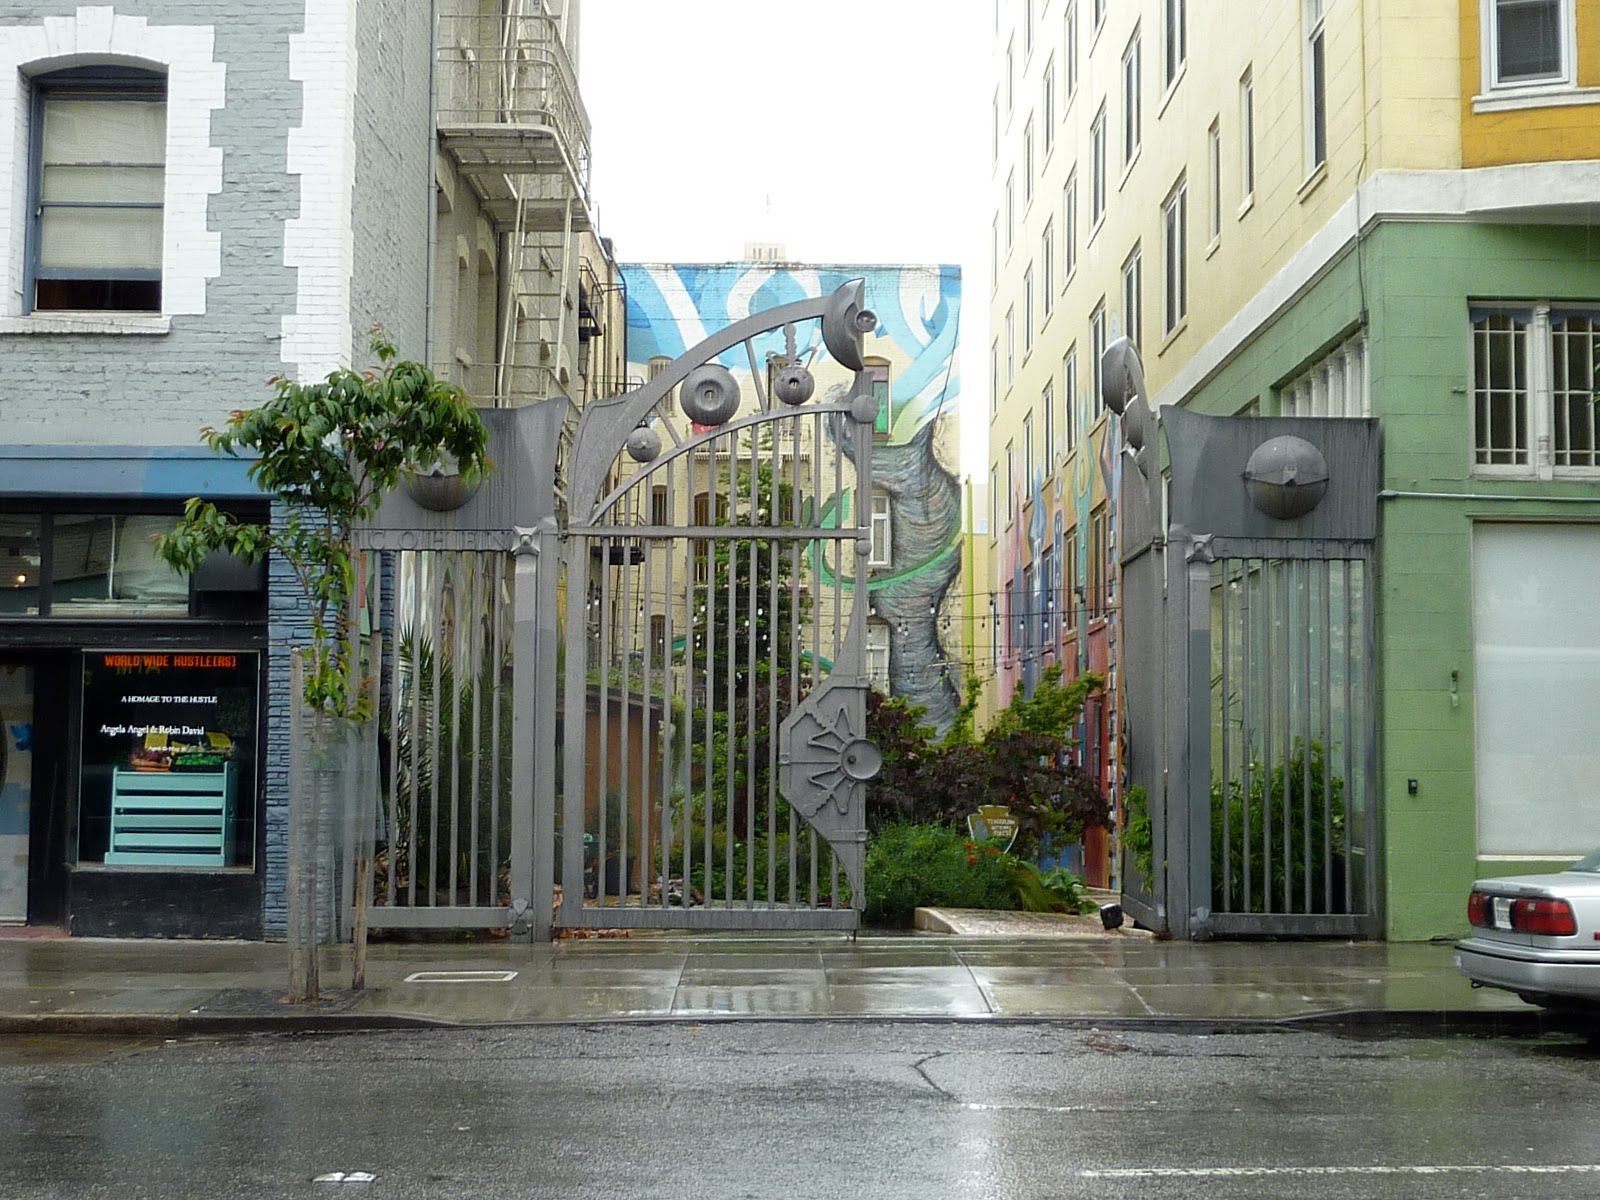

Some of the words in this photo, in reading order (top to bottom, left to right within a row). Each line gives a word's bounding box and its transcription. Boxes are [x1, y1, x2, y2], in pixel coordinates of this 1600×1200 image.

[105, 655, 140, 667] WORLD
[143, 655, 169, 667] WIDE
[100, 724, 126, 737] Angela
[127, 725, 149, 737] Angel
[159, 725, 181, 735] Robin
[181, 725, 204, 735] David
